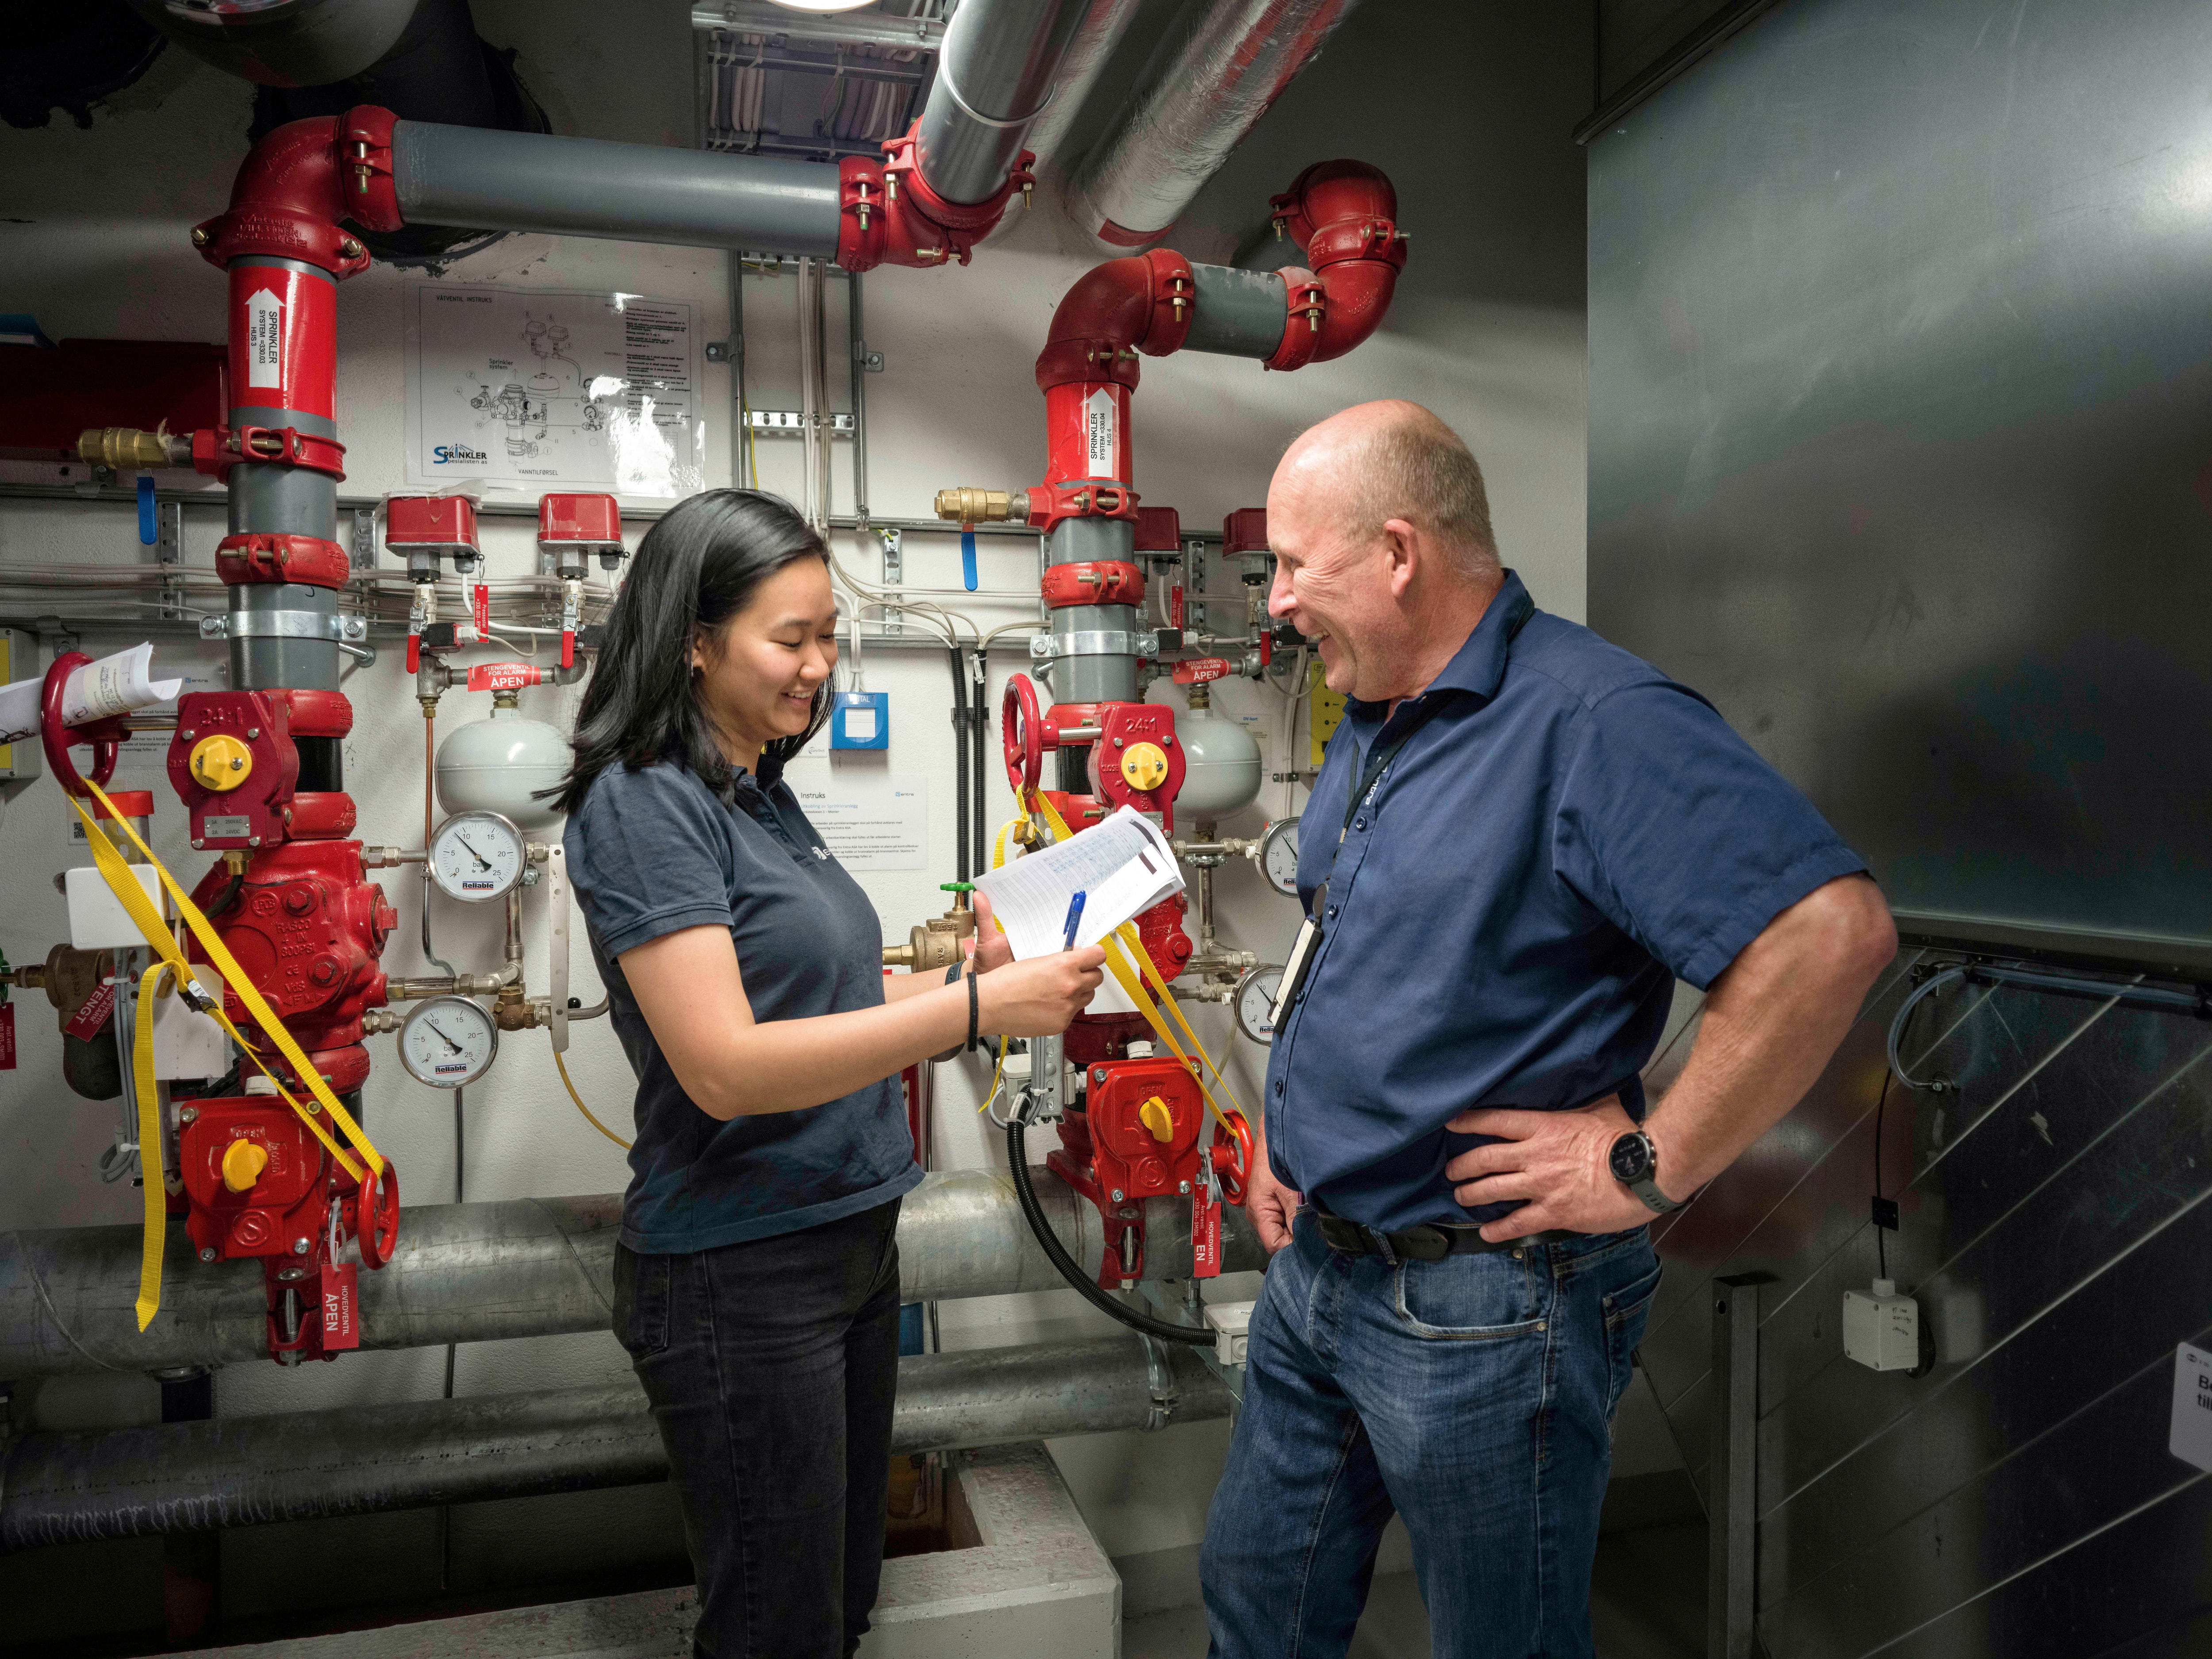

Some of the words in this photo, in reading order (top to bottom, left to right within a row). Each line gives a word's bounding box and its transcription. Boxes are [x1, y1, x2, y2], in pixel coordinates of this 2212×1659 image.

[269, 311, 277, 364] SPRINKLER
[491, 677, 524, 687] ÅPEN
[1194, 671, 1219, 680] ÅPEN
[200, 708, 242, 726] 24:1
[1125, 718, 1157, 733] 24:1
[296, 931, 308, 943] IN
[281, 942, 316, 957] 300PSI
[285, 980, 305, 993] VdS
[76, 985, 109, 1024] TENGT
[89, 1000, 107, 1022] ALARM
[326, 1293, 339, 1331] ÅPEN
